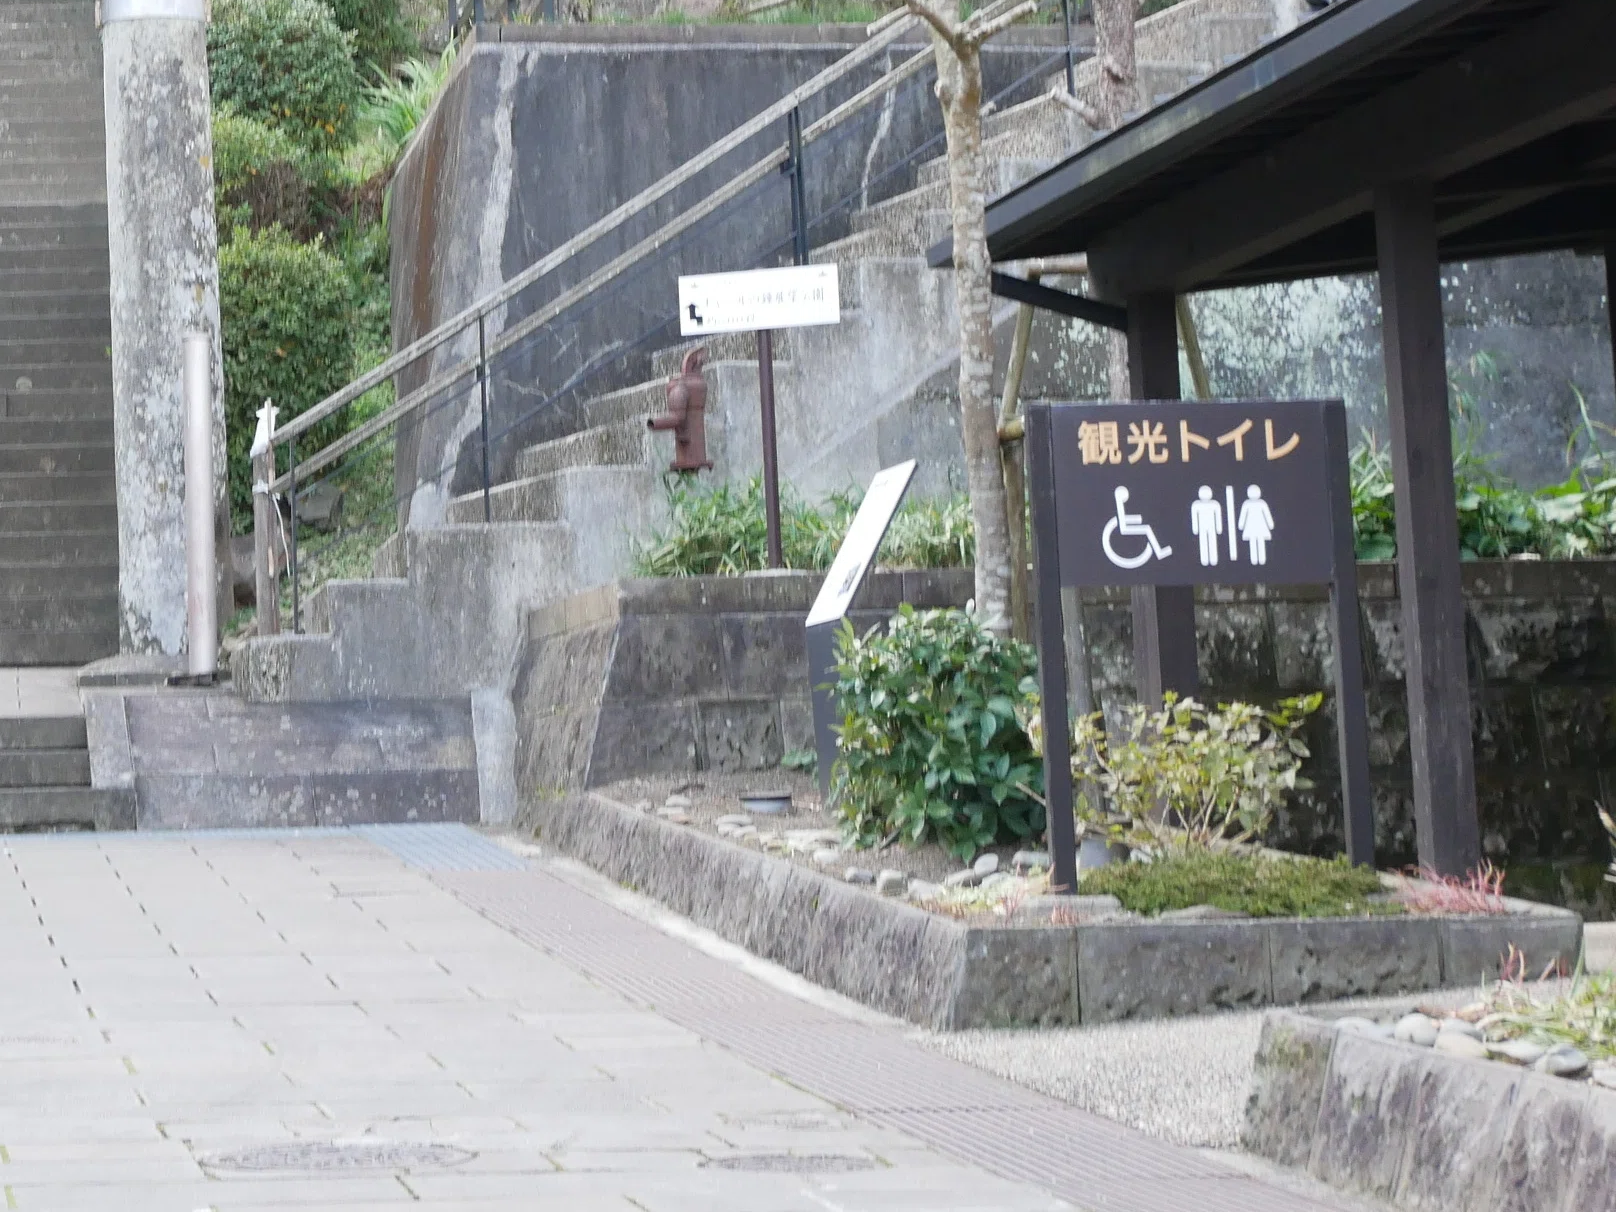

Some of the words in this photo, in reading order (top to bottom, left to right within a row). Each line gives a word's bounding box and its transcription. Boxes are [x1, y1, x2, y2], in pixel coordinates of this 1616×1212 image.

[1077, 419, 1300, 465] 観光トイレ
